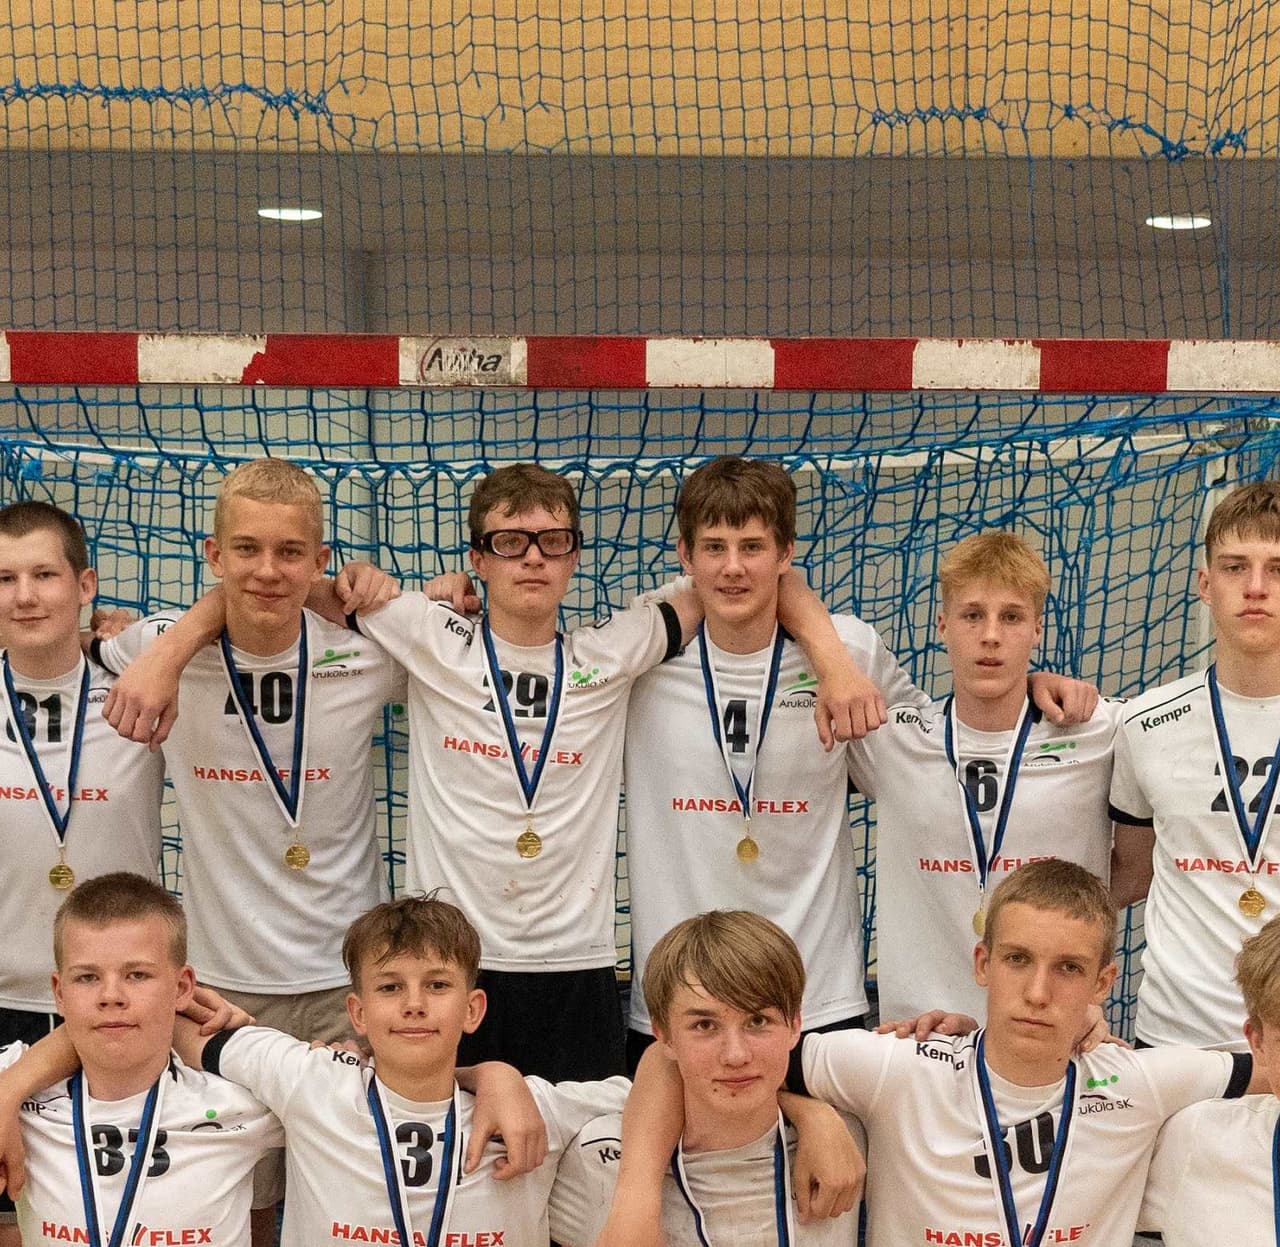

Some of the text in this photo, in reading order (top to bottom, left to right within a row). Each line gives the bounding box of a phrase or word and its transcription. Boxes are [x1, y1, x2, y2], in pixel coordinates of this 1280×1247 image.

[482, 669, 549, 718] 29
[723, 699, 750, 753] 4
[1141, 703, 1192, 732] Kempa
[193, 765, 331, 782] HANSA FEX
[965, 759, 998, 813] 6
[673, 797, 809, 814] HANSA FLEX
[919, 857, 977, 873] HANS
[1174, 857, 1249, 874] HANSA
[1116, 1097, 1134, 1111] SK
[149, 1227, 214, 1247] FLEX
[924, 1227, 1005, 1247] HANS
